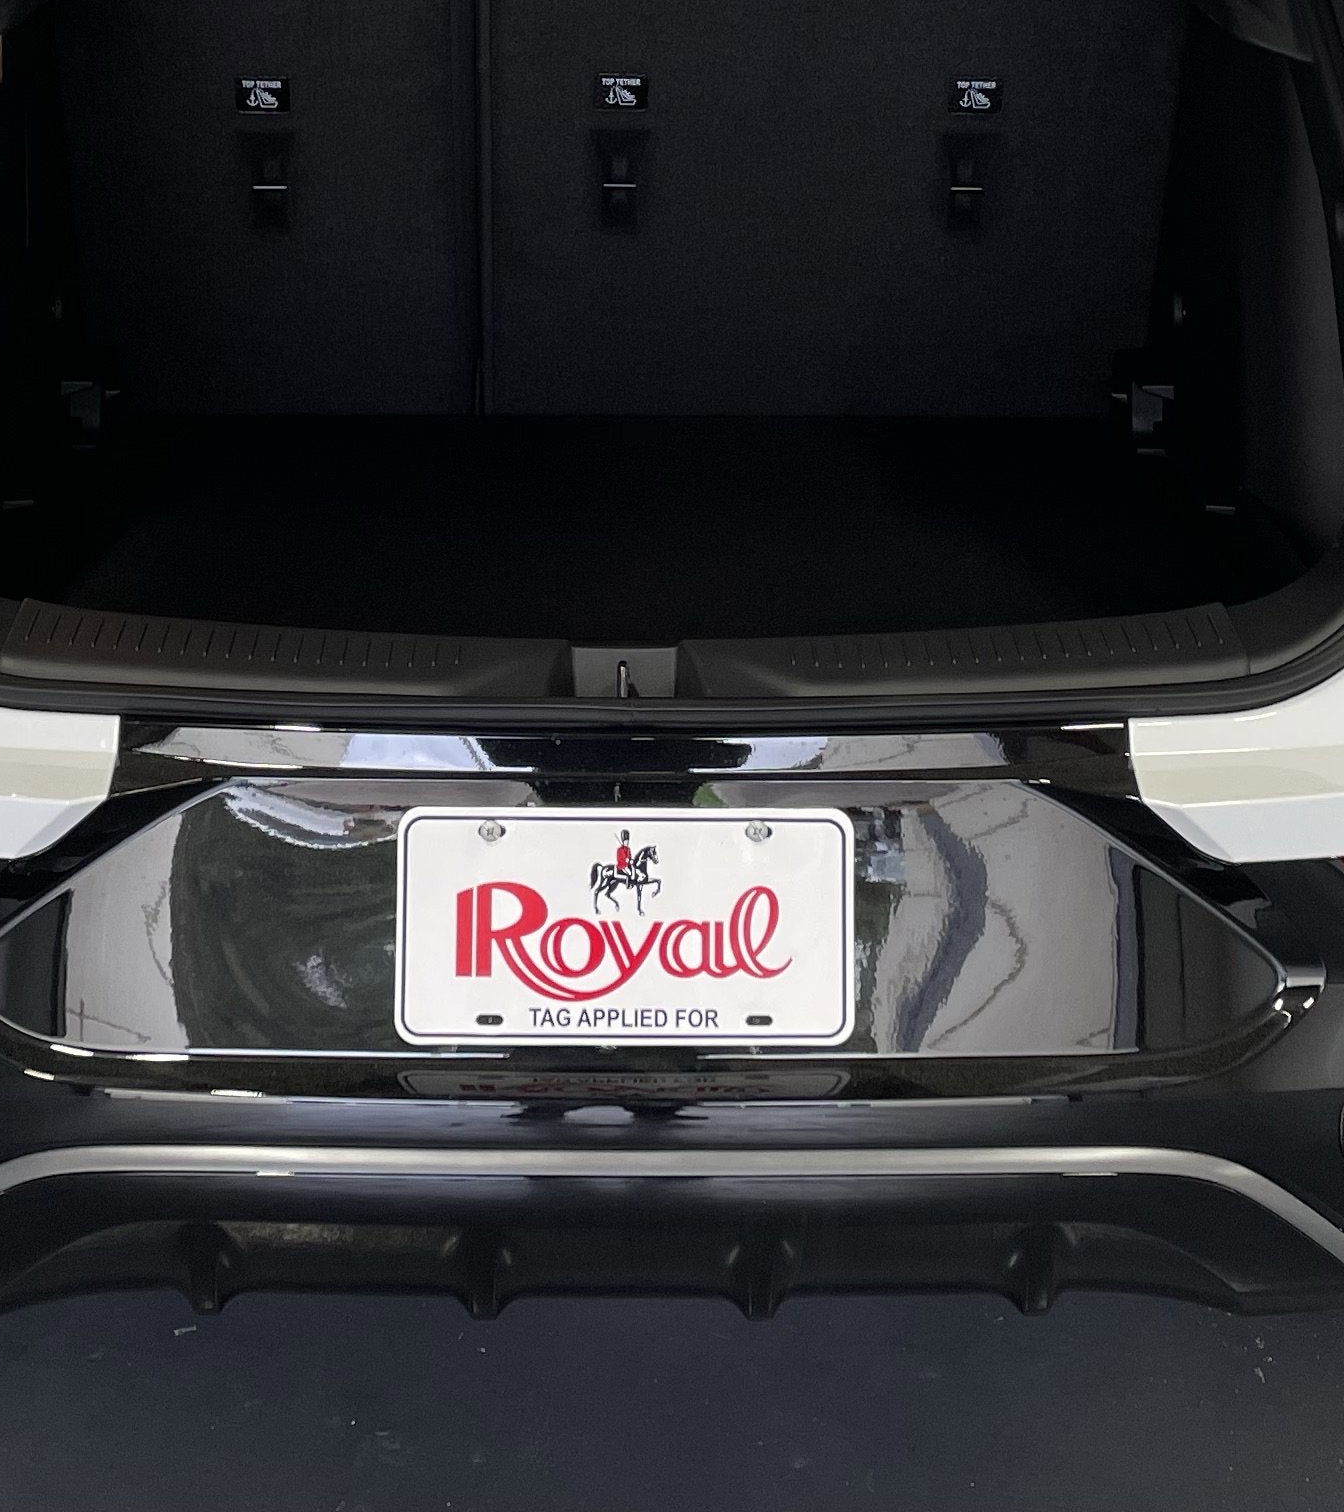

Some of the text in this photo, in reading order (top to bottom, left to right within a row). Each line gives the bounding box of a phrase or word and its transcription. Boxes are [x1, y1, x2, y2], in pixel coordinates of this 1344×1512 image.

[241, 80, 282, 89] TOP TETHER
[601, 77, 641, 86] TOP TETHER
[956, 81, 997, 89] TOP TETHER
[455, 881, 793, 1002] Royal
[529, 1007, 719, 1028] TAG APPLIED FOR
